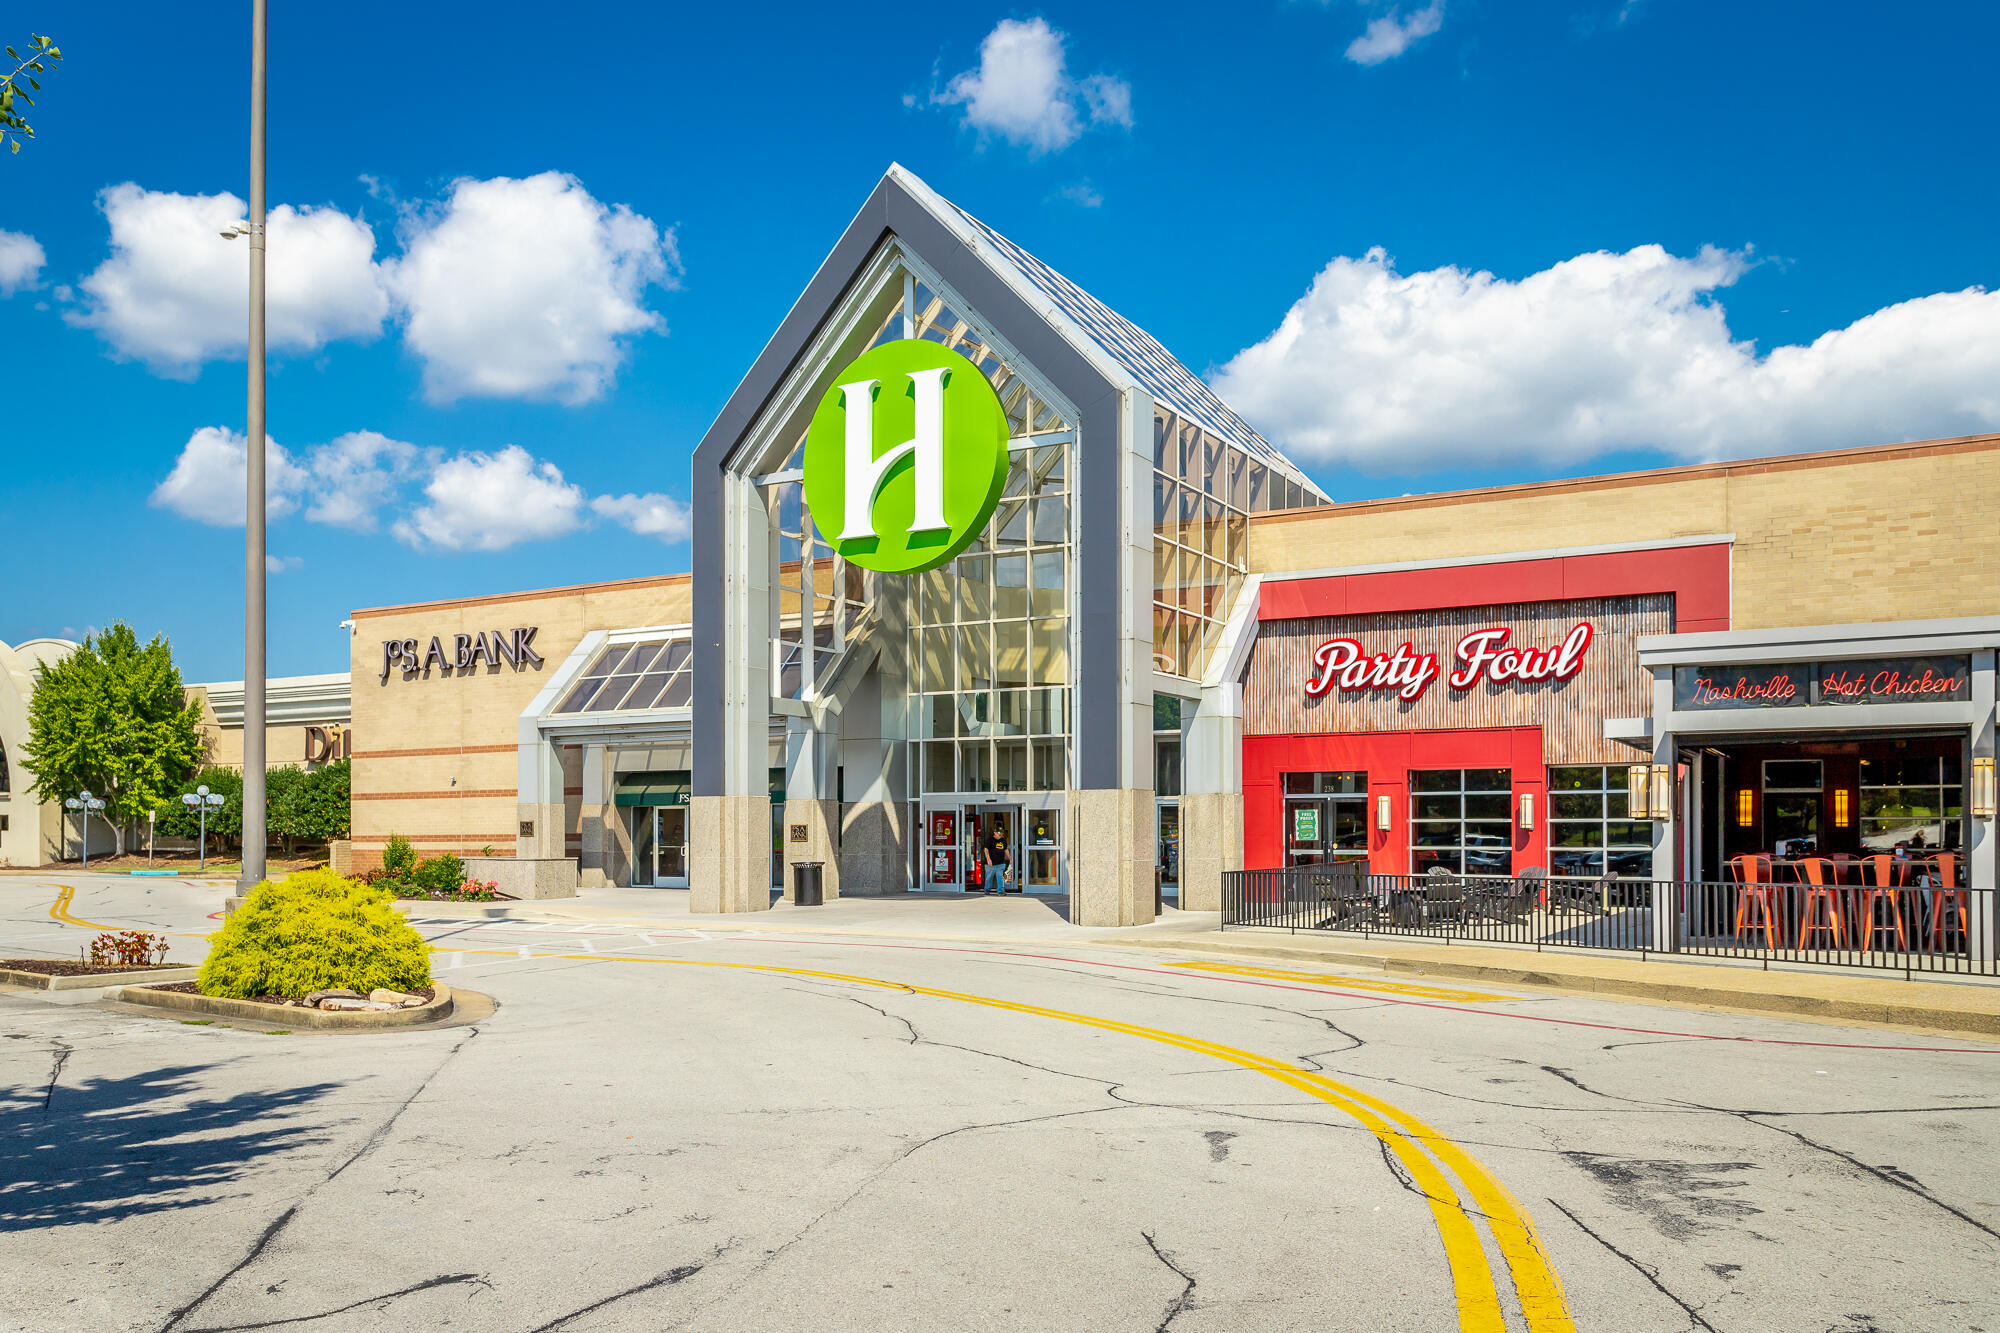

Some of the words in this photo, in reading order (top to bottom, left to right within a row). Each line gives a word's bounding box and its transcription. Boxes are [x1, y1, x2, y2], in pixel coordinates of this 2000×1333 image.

[837, 367, 953, 541] H
[454, 626, 545, 669] BANK
[1305, 638, 1440, 700] Party
[1450, 621, 1594, 690] Fowl
[1692, 675, 1796, 705] Nashville
[1822, 671, 1867, 696] Hot
[1870, 669, 1964, 696] Chicken
[1323, 785, 1335, 793] 238
